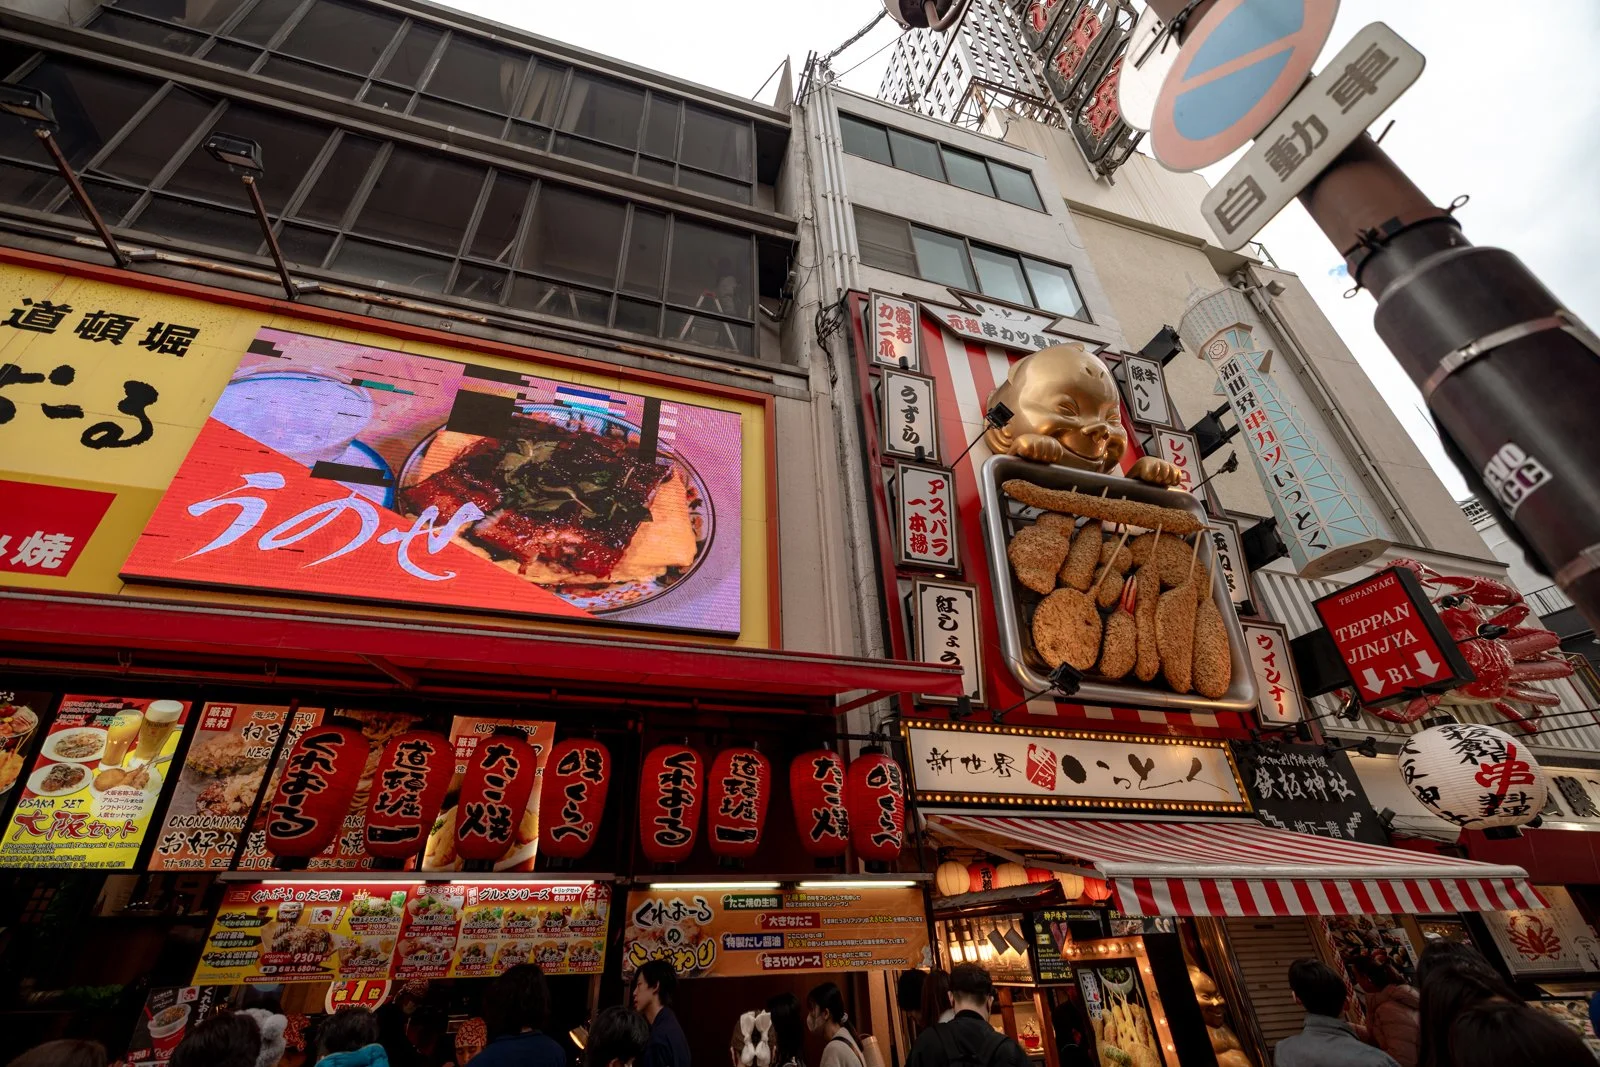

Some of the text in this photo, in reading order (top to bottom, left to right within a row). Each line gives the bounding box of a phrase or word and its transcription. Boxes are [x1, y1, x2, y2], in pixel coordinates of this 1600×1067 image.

[1214, 43, 1399, 235] 自動車
[1, 297, 200, 357] 道頓堀
[895, 306, 913, 345] 海老
[900, 385, 920, 444] うずら
[908, 497, 929, 555] 一本揚
[928, 479, 948, 557] アスパラ
[0, 529, 75, 569] 焼
[1339, 576, 1395, 606] TEPPANYAKI
[1335, 602, 1411, 643] TEPPAN
[1347, 628, 1418, 665] JINJYA
[1256, 634, 1286, 716] ウインナー
[1385, 664, 1415, 685] B1
[204, 718, 230, 729] 素材
[926, 747, 1022, 778] 新世界
[268, 732, 345, 840] くれおーる
[458, 742, 519, 842] たこ焼
[654, 751, 697, 847] くれおーる
[810, 755, 849, 843] たこ焼
[1253, 766, 1356, 802] 鉄板神社
[18, 798, 85, 808] OSAKA SET
[13, 809, 139, 841] 大阪セット
[479, 888, 550, 901] グルメシリーズ
[635, 898, 711, 927] くれおーる
[729, 896, 778, 908] たこ焼の生地
[224, 912, 247, 921] ソース
[769, 915, 813, 927] 大きなたこ
[667, 928, 681, 944] の
[725, 935, 782, 949] 特製だし醤油
[764, 954, 822, 969] まろやかソース
